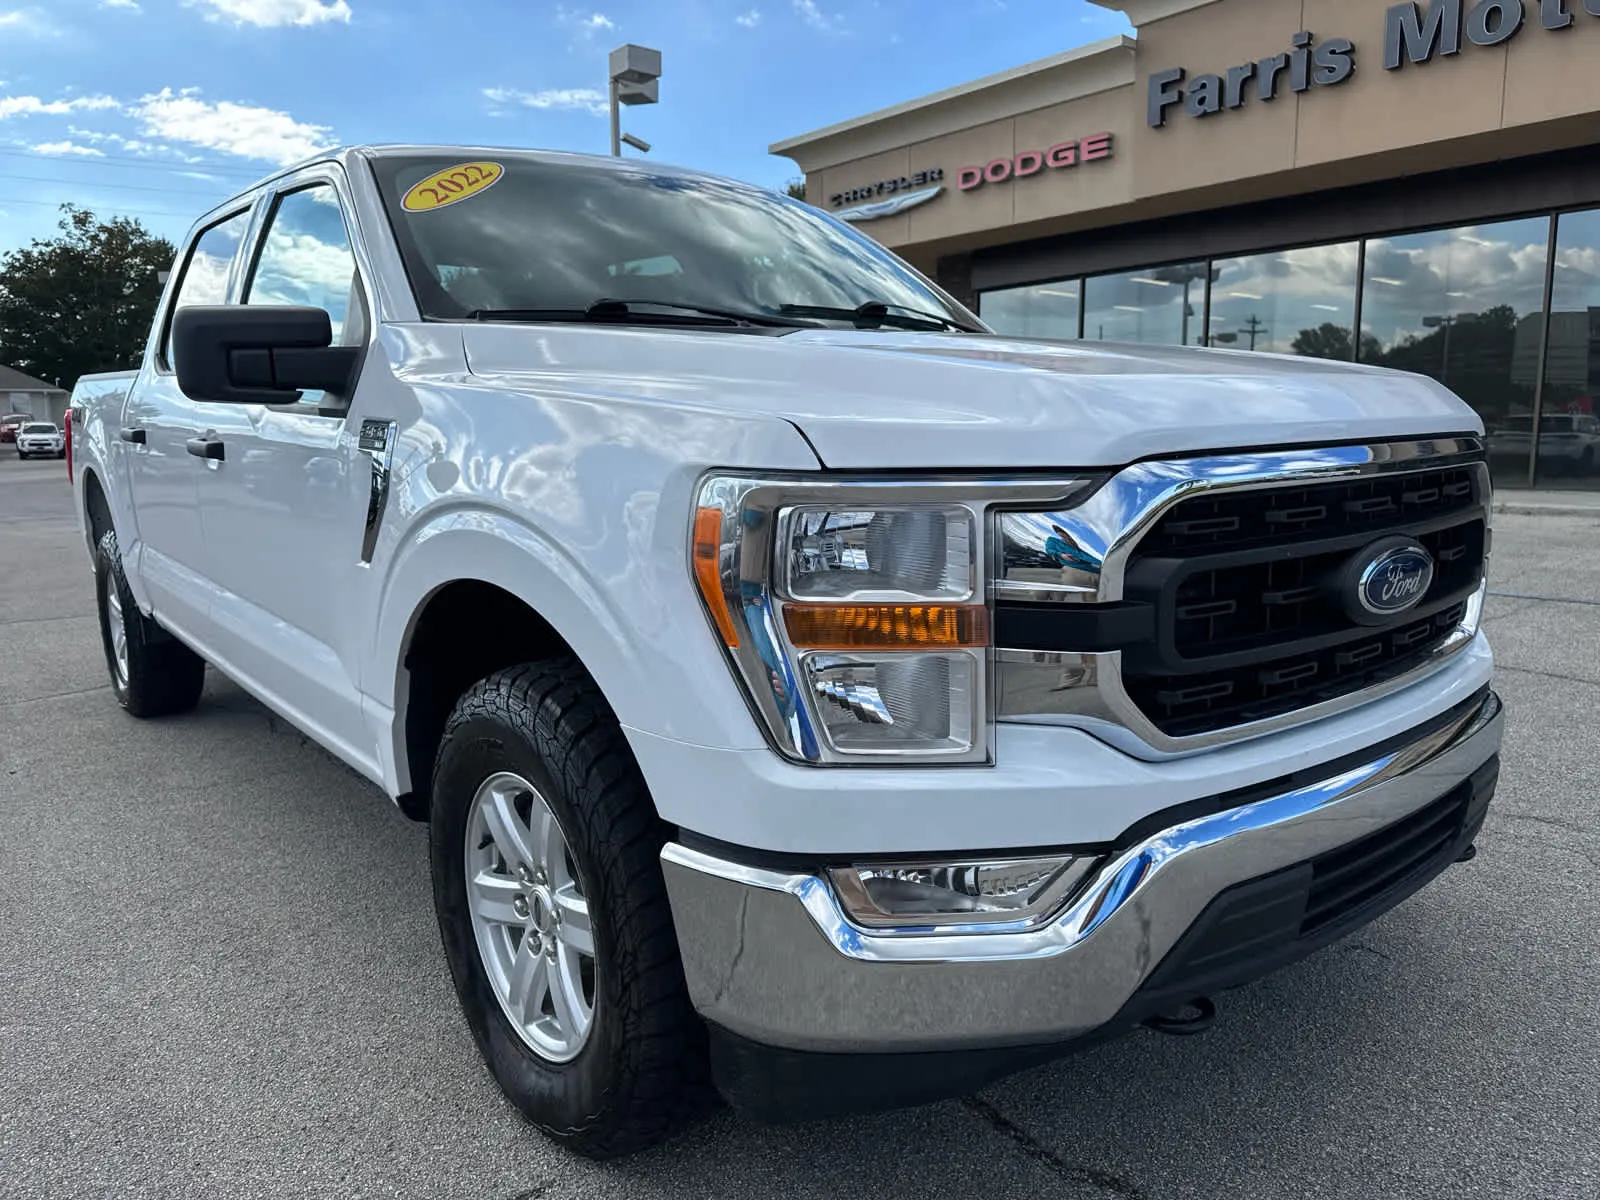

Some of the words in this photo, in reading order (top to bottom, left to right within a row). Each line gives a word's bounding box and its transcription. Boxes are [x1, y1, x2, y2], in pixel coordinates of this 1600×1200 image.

[1147, 31, 1356, 129] Farris
[1383, 0, 1600, 71] Mo
[957, 131, 1115, 192] DODGE
[419, 165, 493, 203] 2022
[830, 168, 945, 208] CHRYSLER
[1382, 561, 1422, 600] Ford
